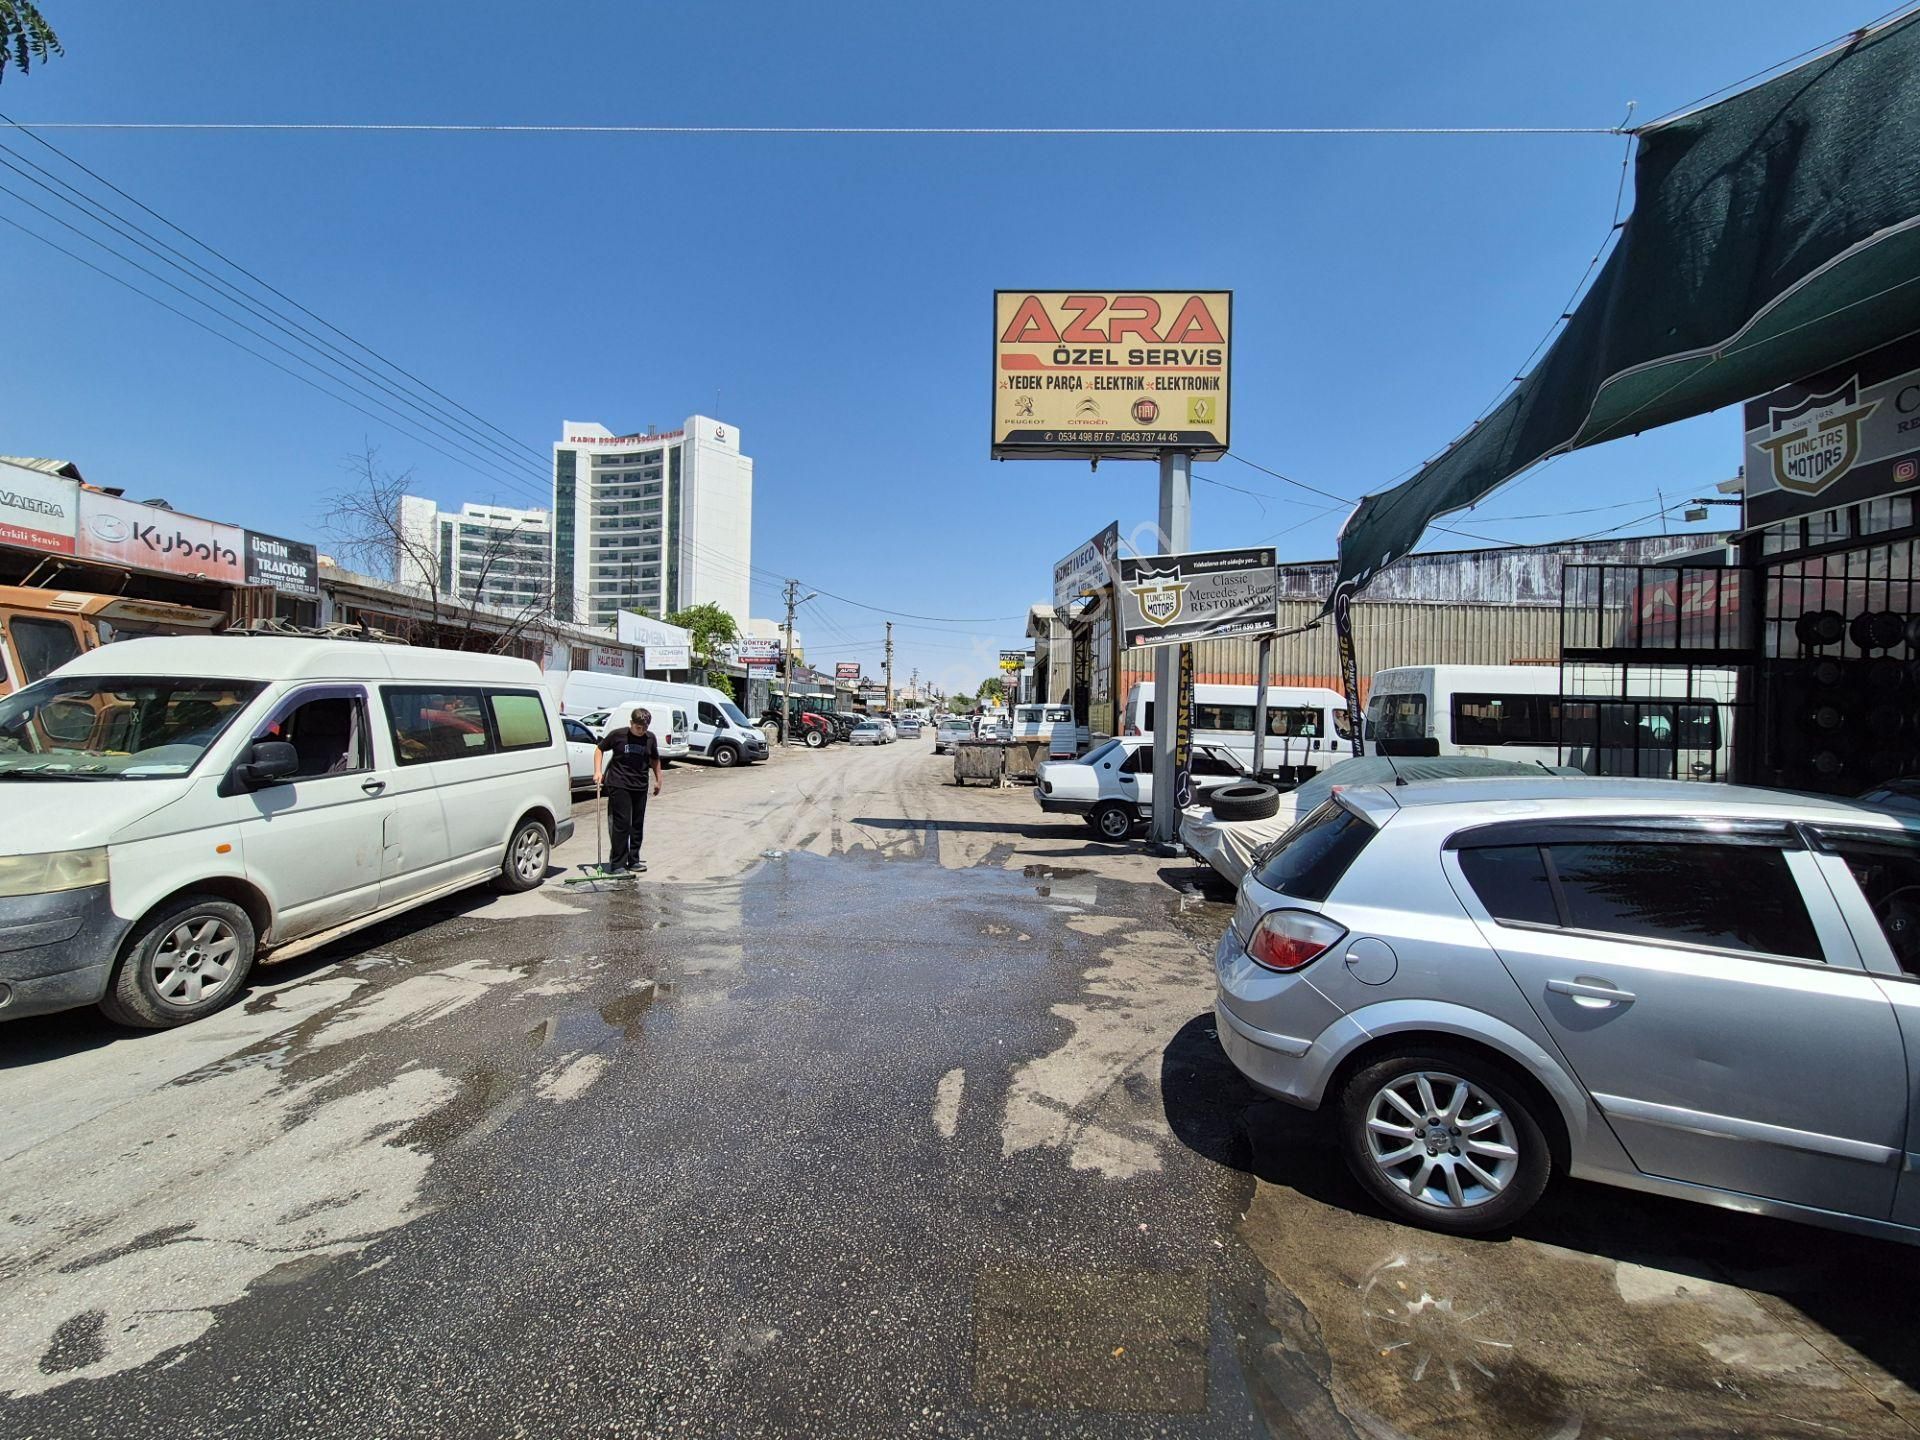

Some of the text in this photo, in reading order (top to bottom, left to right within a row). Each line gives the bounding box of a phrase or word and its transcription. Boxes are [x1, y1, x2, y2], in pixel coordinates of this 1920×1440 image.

[1000, 295, 1226, 343] AZRA
[1053, 345, 1119, 365] ÖZEL
[1008, 376, 1042, 390] YEDEK
[1047, 376, 1082, 392] PARÇA
[1137, 404, 1155, 419] FIAT
[1058, 432, 1076, 441] 0534
[1078, 432, 1092, 441] 498
[1094, 432, 1104, 441] 87
[1105, 432, 1115, 441] 67
[1121, 432, 1138, 441] 0543
[1139, 432, 1155, 441] 737
[1157, 432, 1167, 441] 44
[1168, 432, 1178, 442] 45
[1788, 446, 1842, 478] MOTORS
[0, 490, 65, 518] VALTRA
[31, 533, 61, 546] Servis
[133, 521, 237, 566] Kubota
[252, 536, 288, 558] ÜSTÜN
[257, 558, 307, 577] TRAKTÖR
[1073, 546, 1095, 571] IVECO
[1212, 575, 1248, 586] Classic
[1189, 587, 1238, 601] Mercedes
[1247, 583, 1276, 596] Benz
[1147, 602, 1174, 616] MOTORS
[1190, 595, 1272, 613] RESTORASYON
